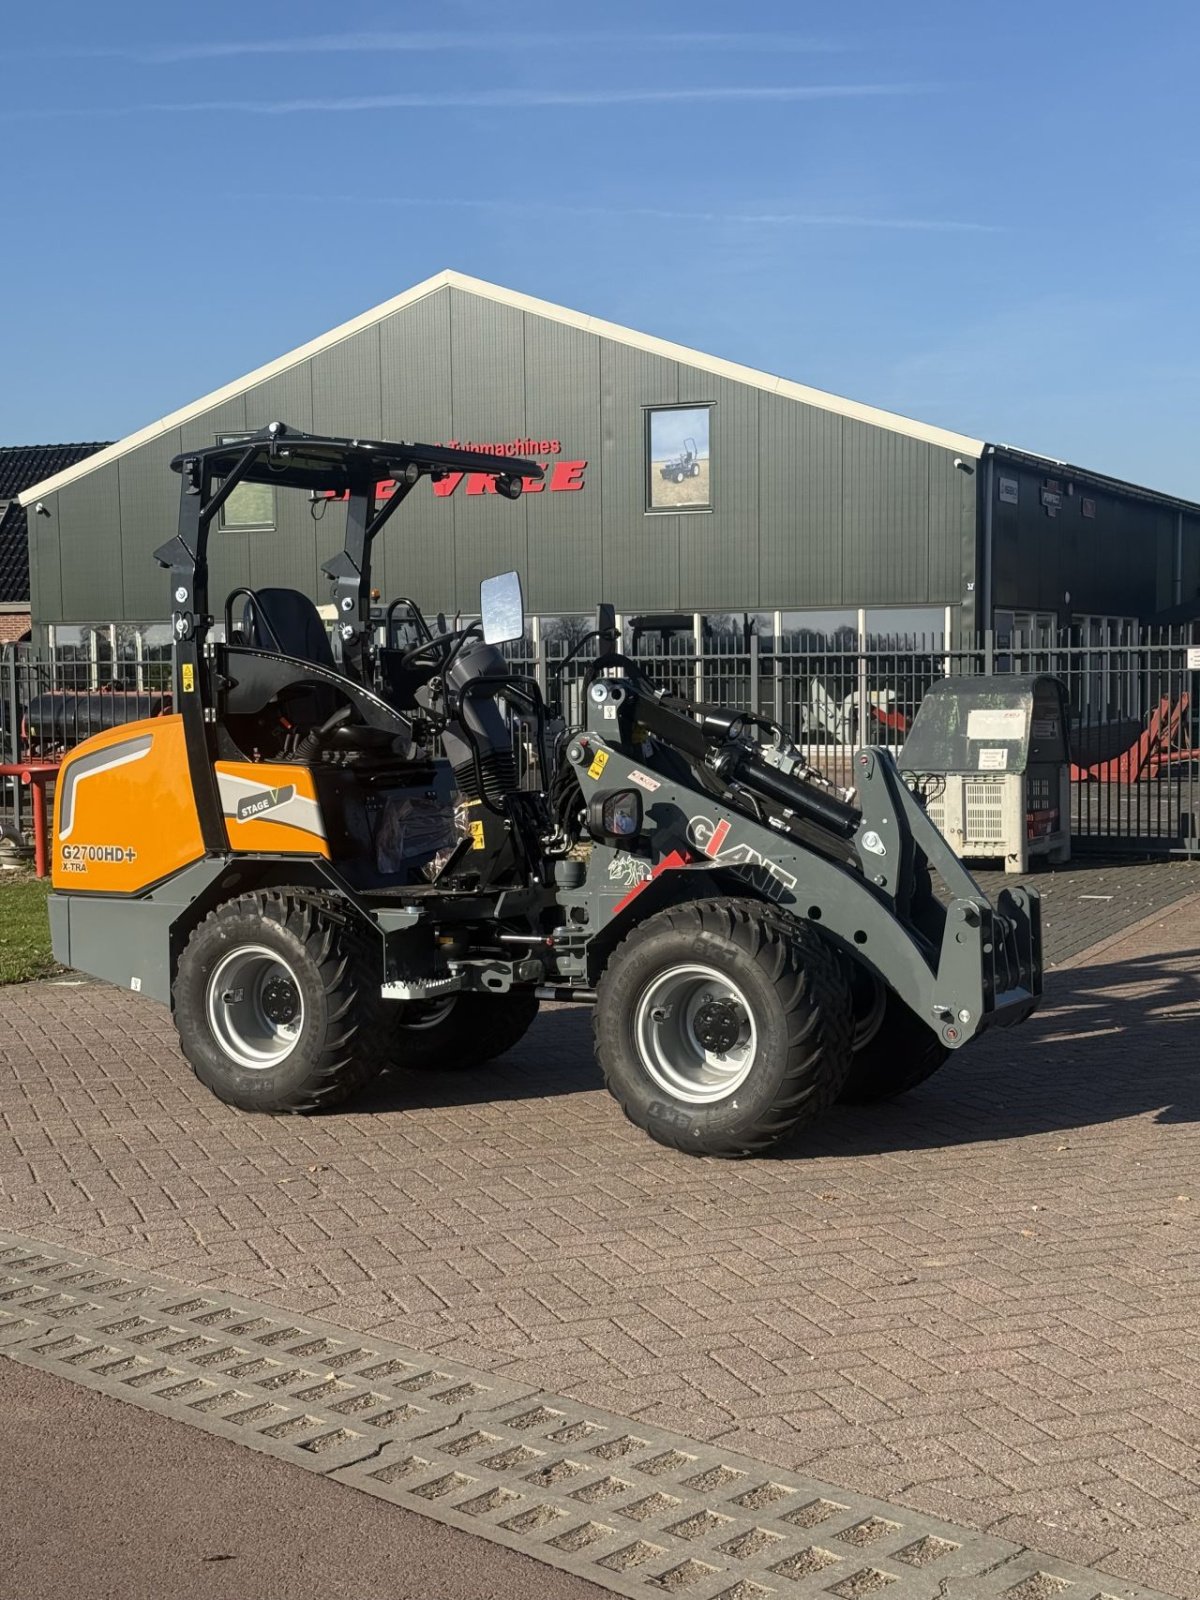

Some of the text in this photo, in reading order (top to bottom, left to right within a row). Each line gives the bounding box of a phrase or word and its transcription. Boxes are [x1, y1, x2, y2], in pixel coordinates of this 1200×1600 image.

[241, 799, 270, 817] STAGE
[61, 844, 136, 863] G2700HD+
[686, 815, 798, 901] GIANT
[62, 862, 88, 872] X-TRA
